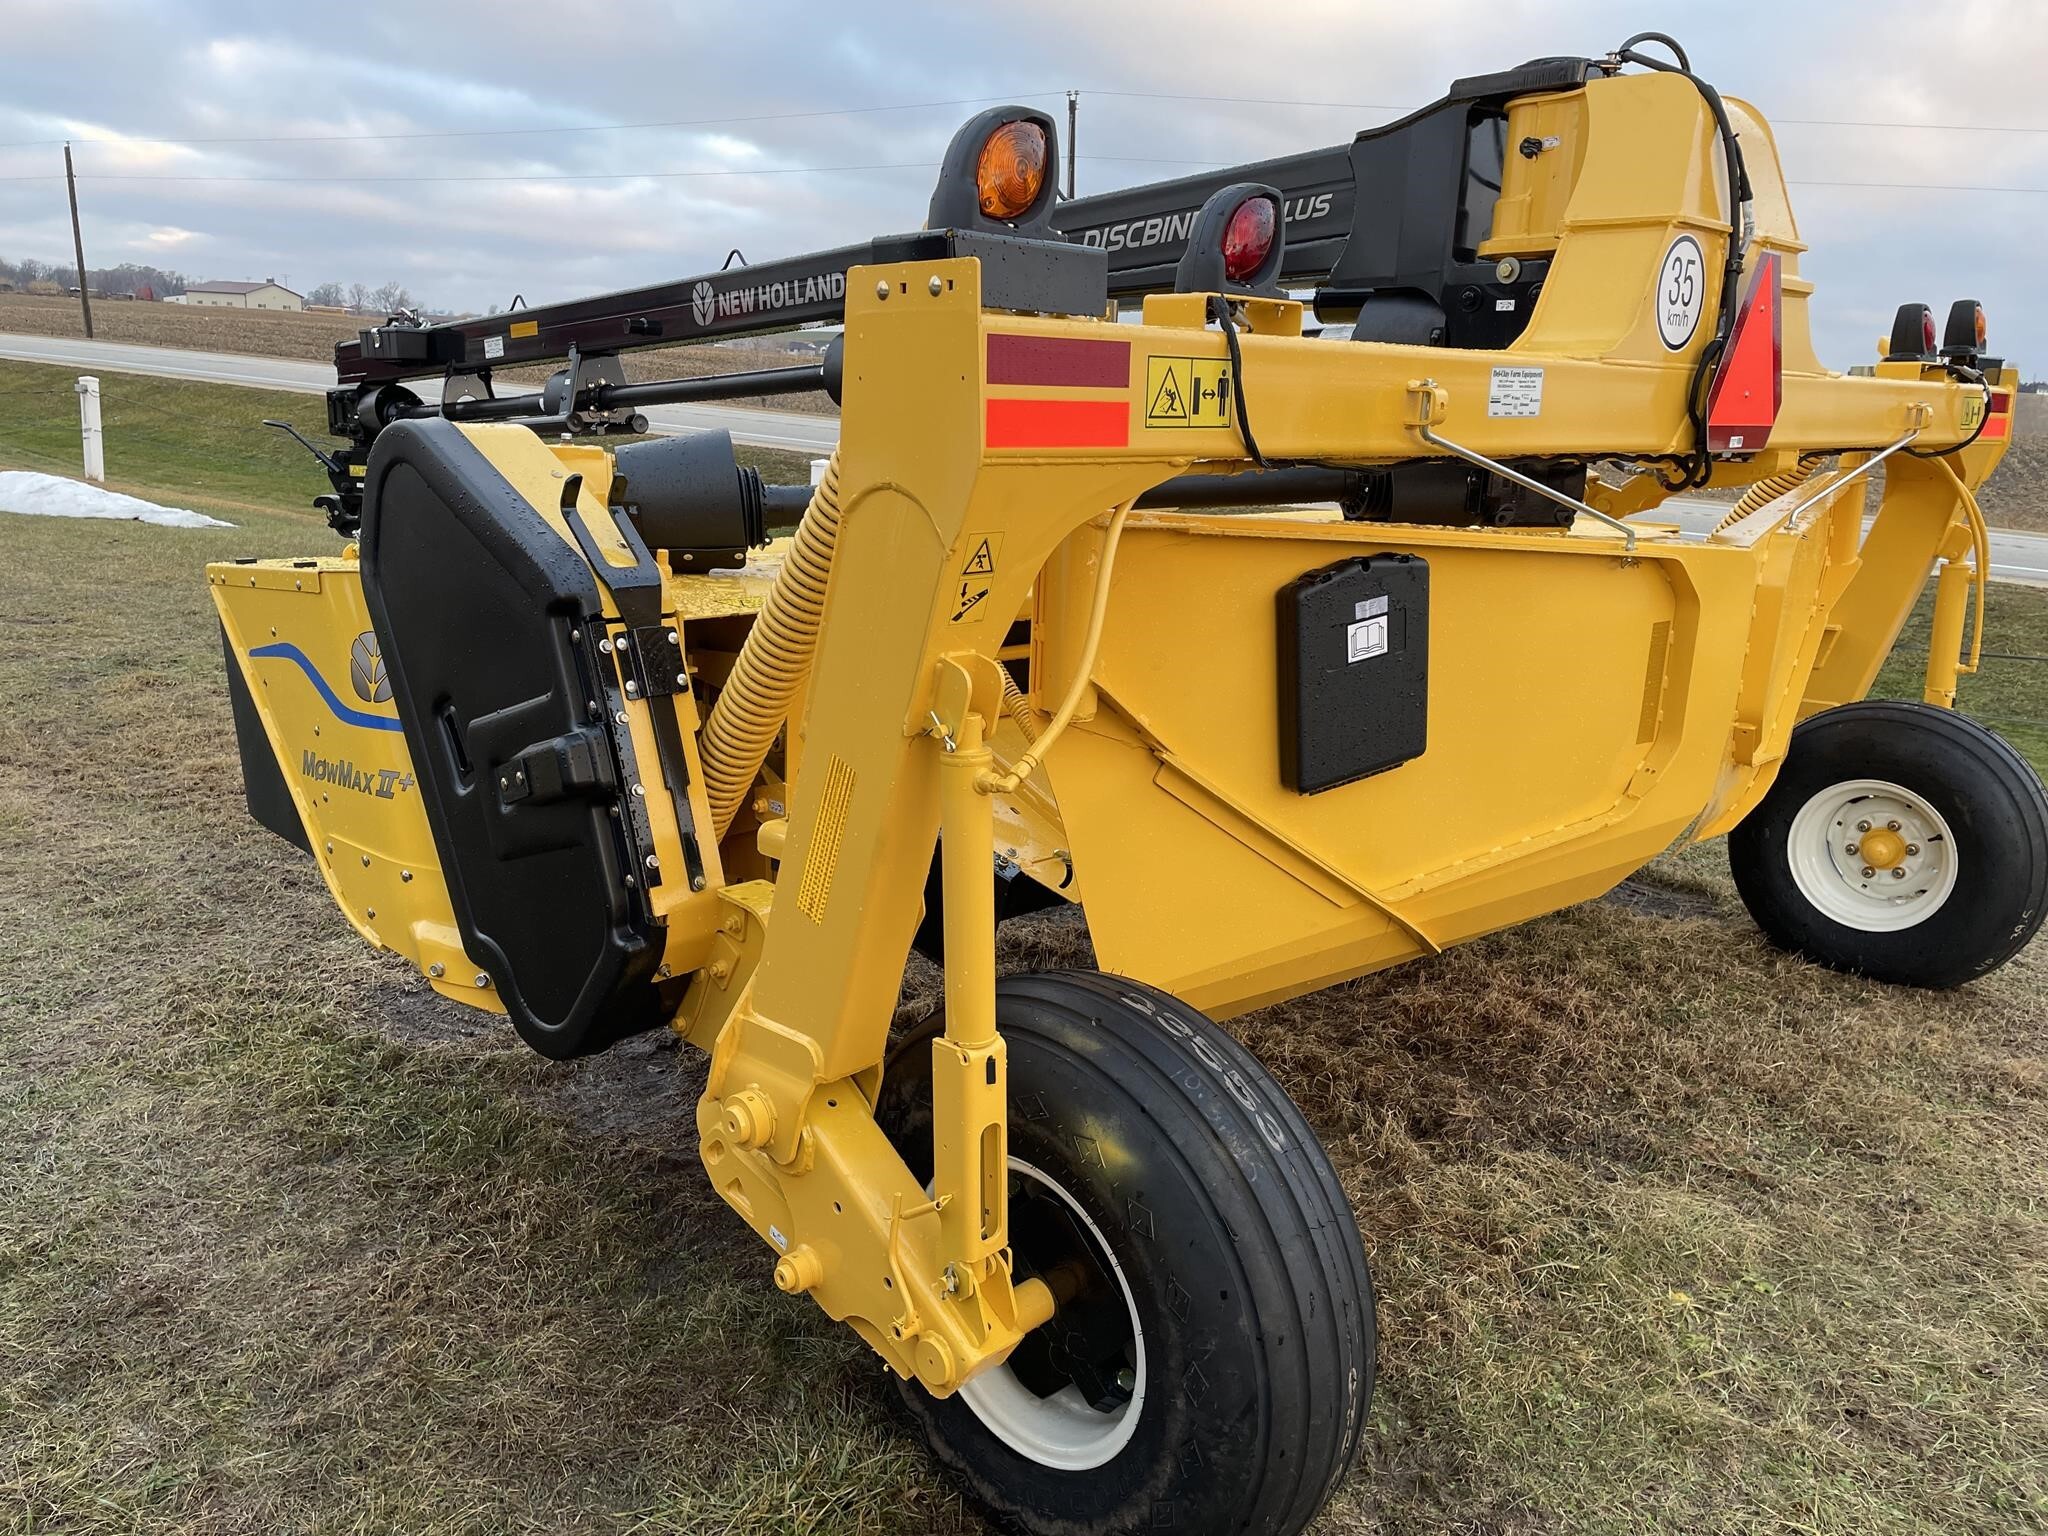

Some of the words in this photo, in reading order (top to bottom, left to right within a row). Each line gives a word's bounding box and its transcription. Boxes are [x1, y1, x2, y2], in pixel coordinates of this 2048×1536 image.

[718, 287, 755, 317] NEW
[758, 272, 845, 311] HOLLAND
[1668, 256, 1696, 307] 35
[1667, 309, 1689, 327] km/h
